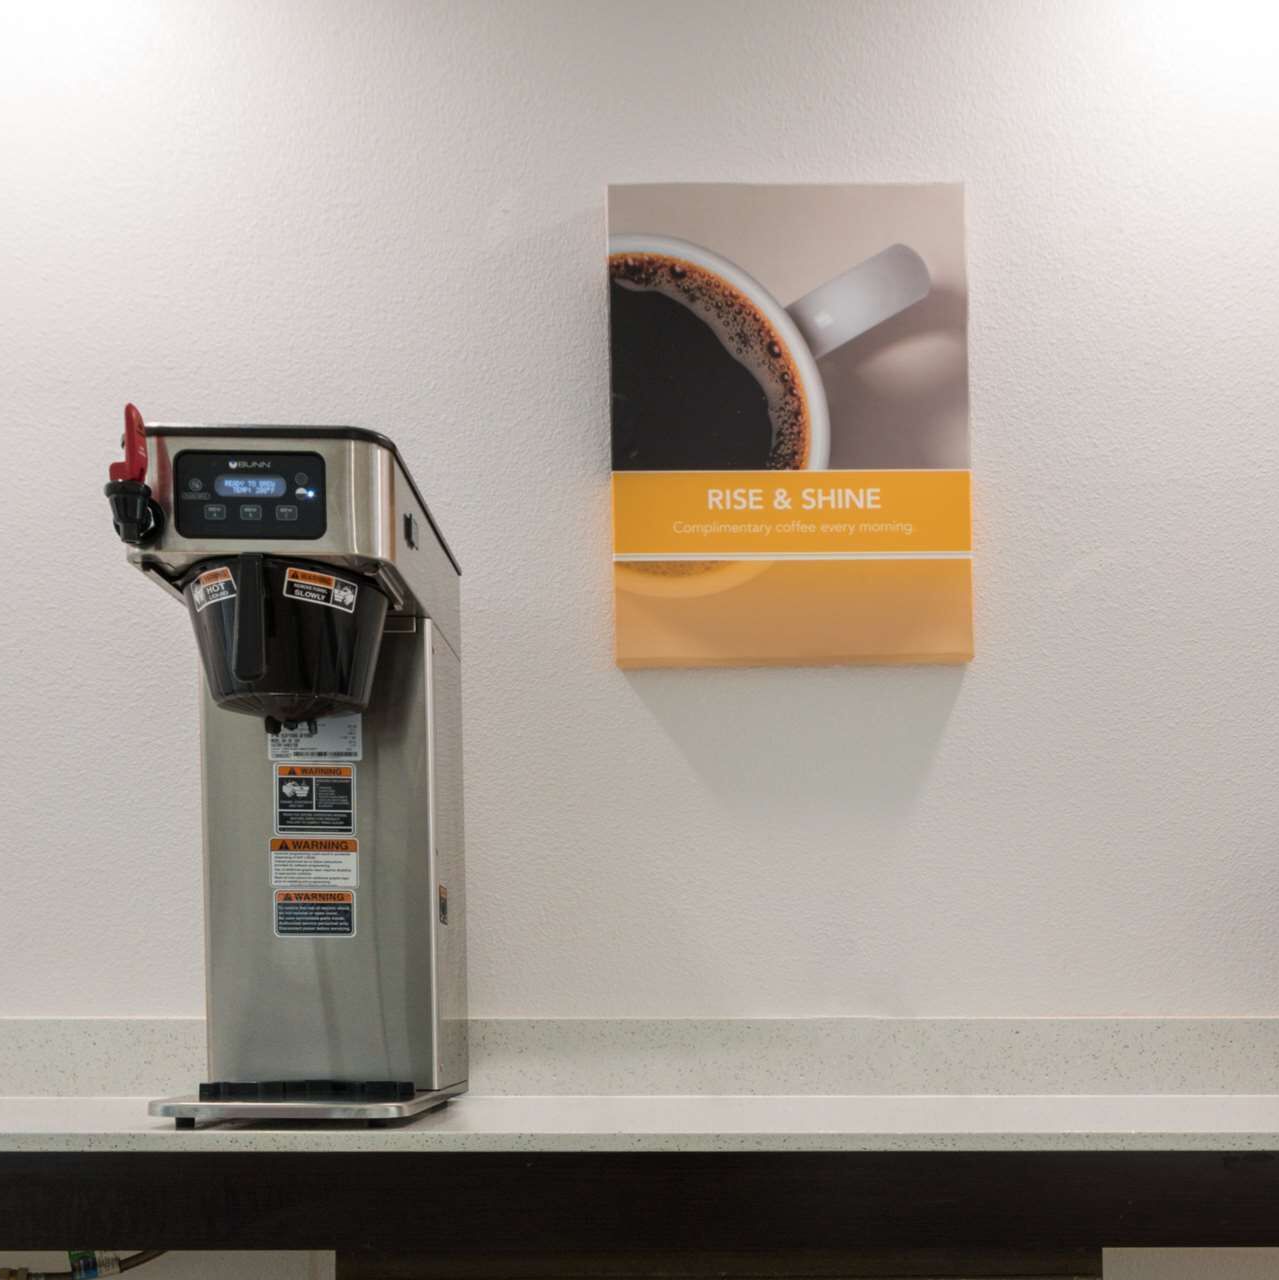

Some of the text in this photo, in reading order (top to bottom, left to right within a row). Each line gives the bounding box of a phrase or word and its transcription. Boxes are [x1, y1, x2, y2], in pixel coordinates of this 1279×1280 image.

[707, 487, 881, 510] RISE & SHINE
[672, 520, 771, 537] Complimentary
[775, 520, 817, 533] coffee
[820, 522, 856, 536] every
[206, 582, 226, 594] HOT
[293, 589, 326, 601] SLOWLY
[301, 767, 342, 775] WARNING
[291, 840, 349, 850] WARNING
[295, 892, 345, 902] WARNING
